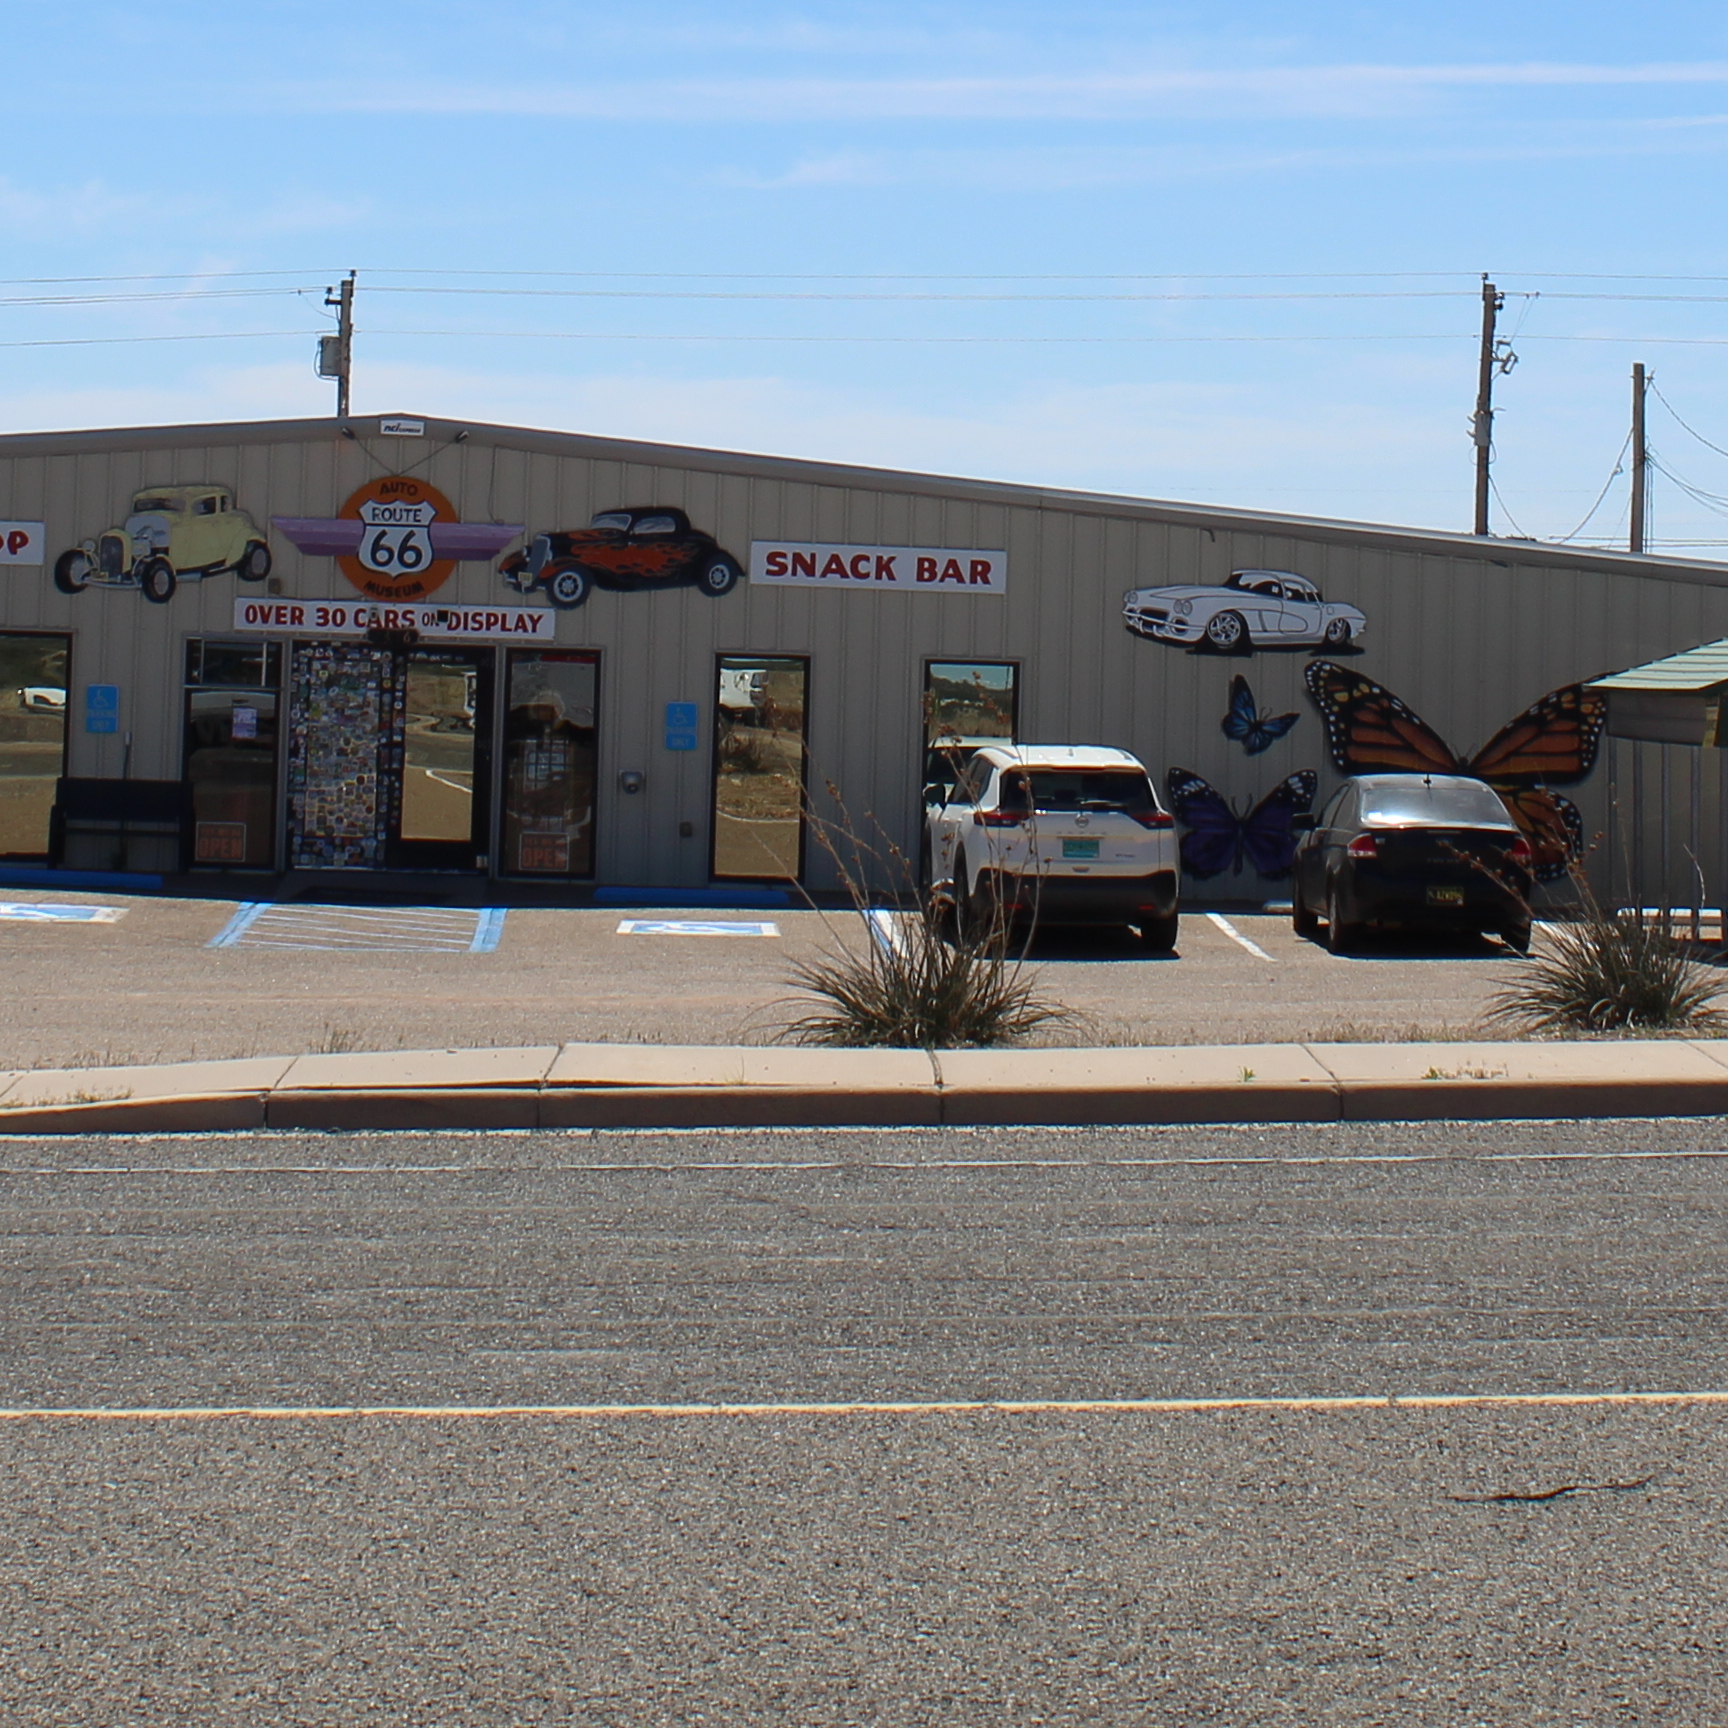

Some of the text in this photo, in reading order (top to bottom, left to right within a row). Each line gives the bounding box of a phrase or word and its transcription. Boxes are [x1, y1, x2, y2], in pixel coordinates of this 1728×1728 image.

[379, 482, 418, 496] AUTO
[372, 507, 422, 522] ROUTE
[370, 529, 422, 568] 66
[765, 550, 992, 586] SNACK BAR
[364, 580, 424, 598] MUSEUM
[244, 604, 305, 625] OVER
[314, 607, 346, 628] 30
[353, 607, 416, 629] CARS
[446, 611, 544, 634] DISPLAY
[199, 838, 243, 858] OPEN
